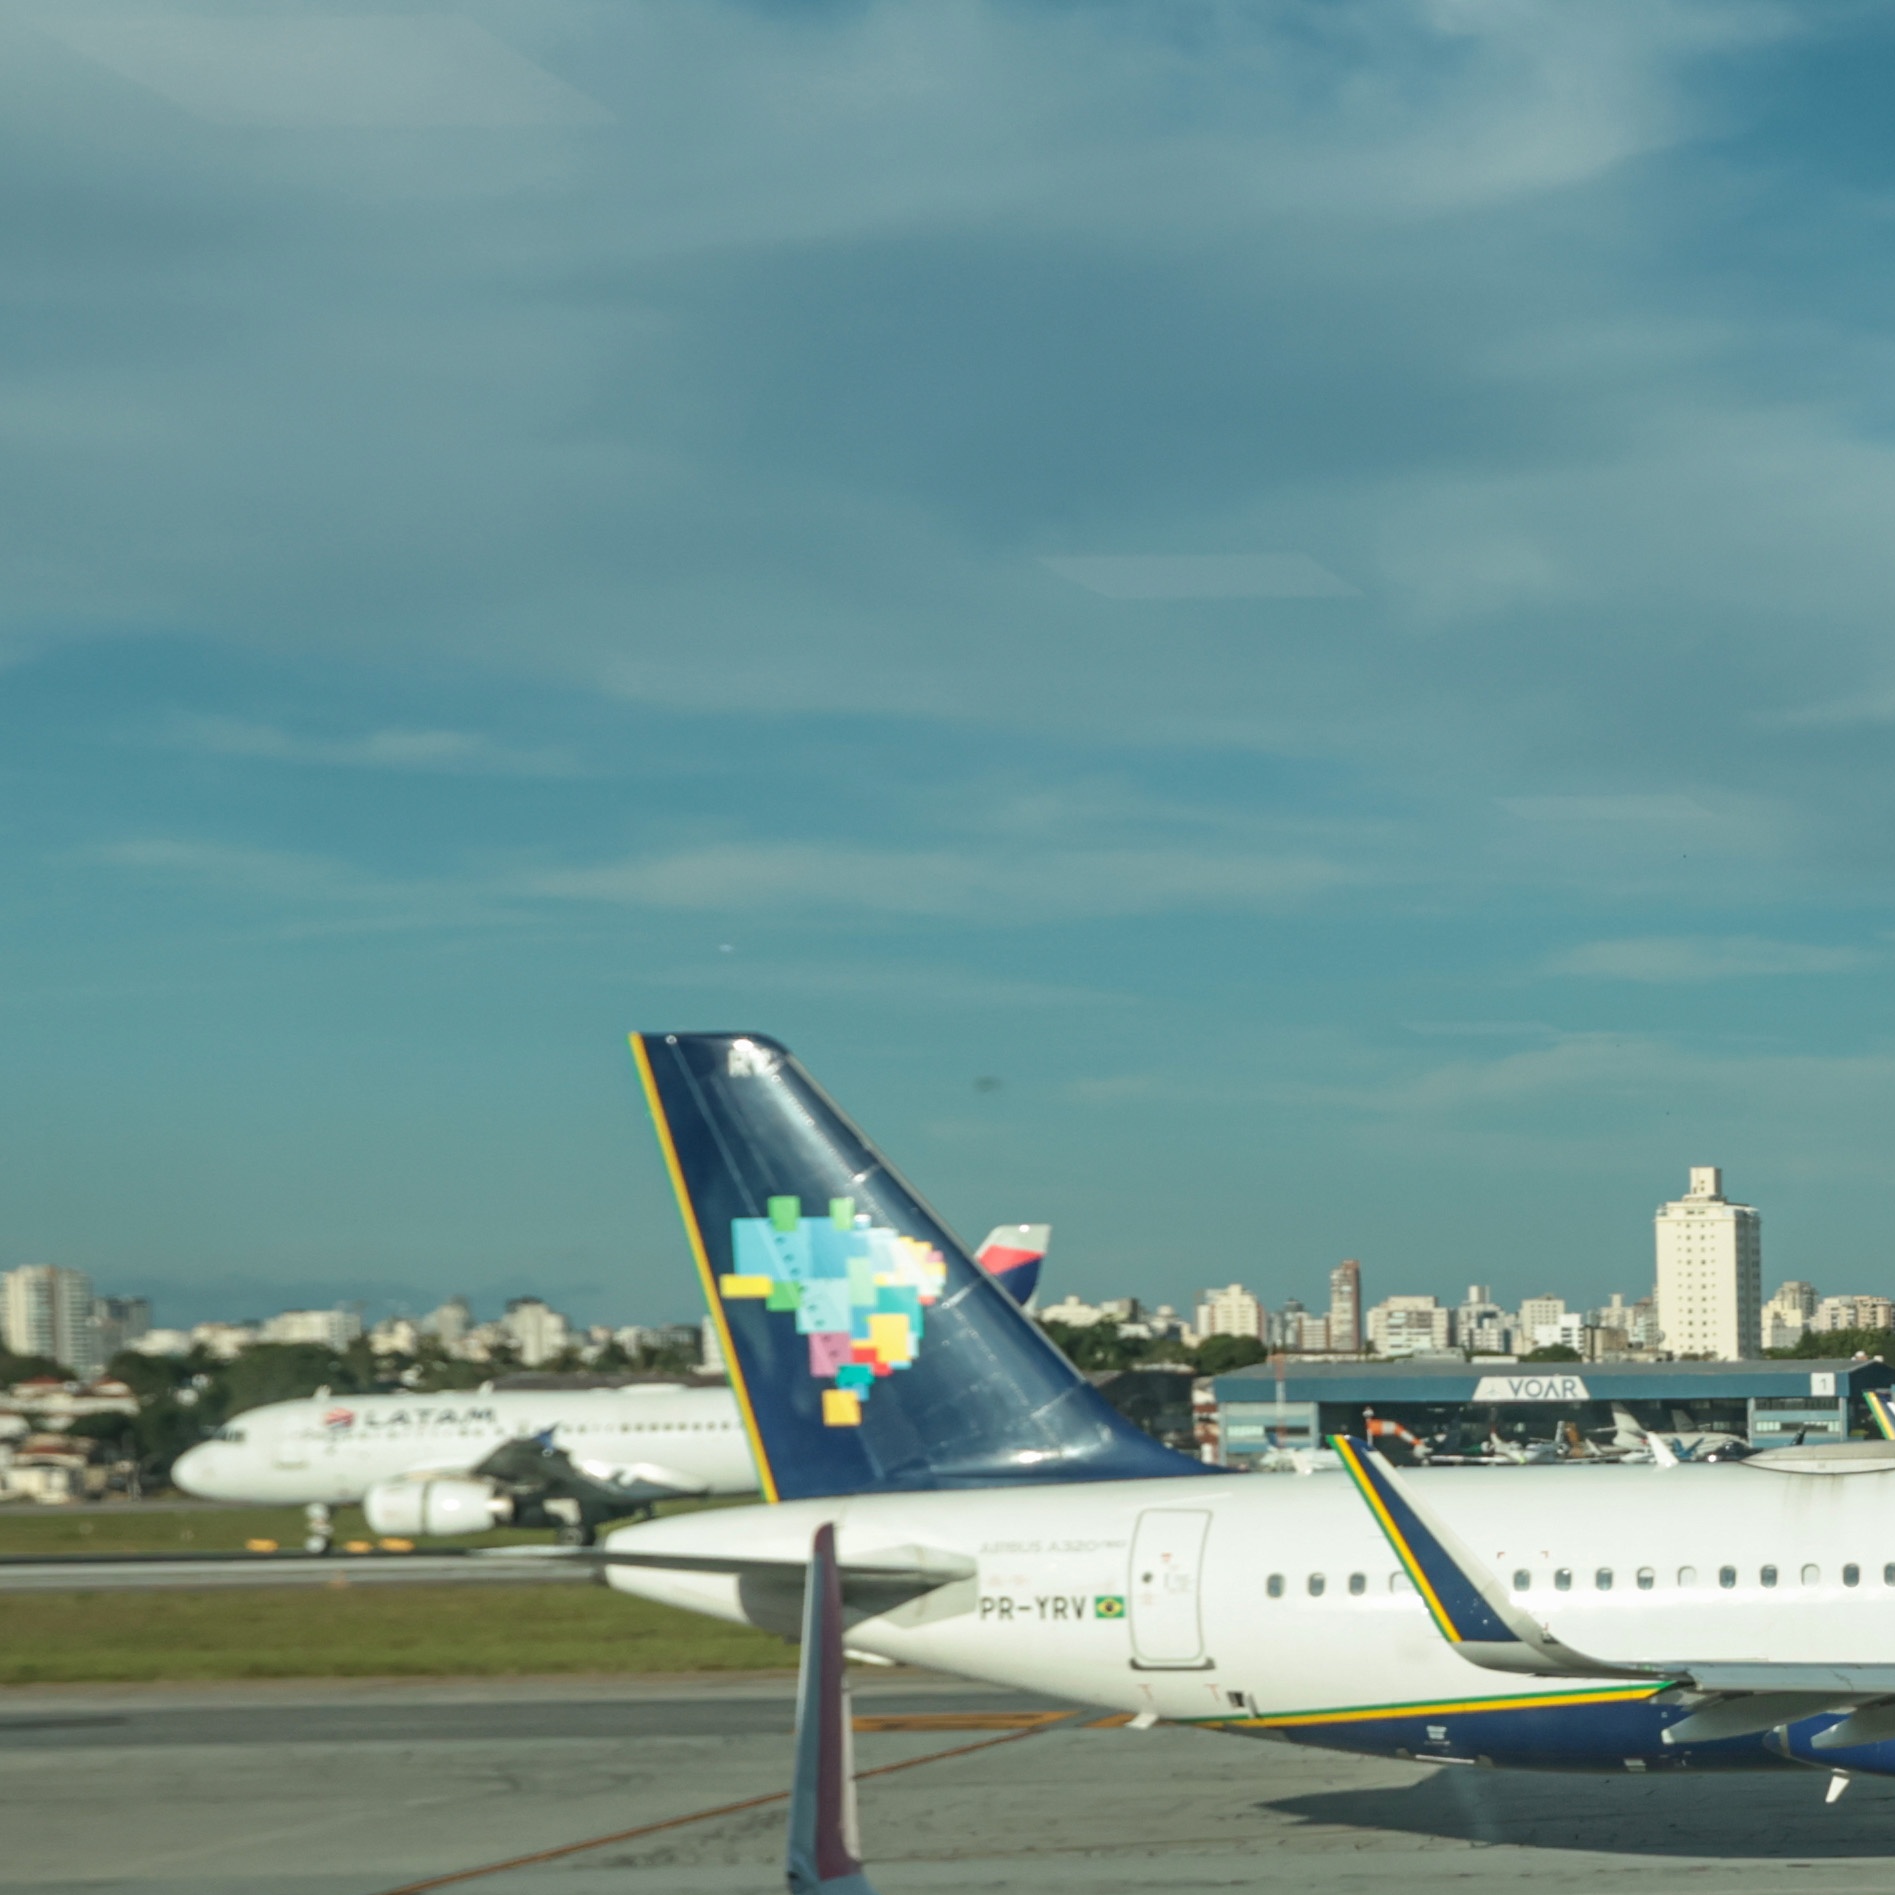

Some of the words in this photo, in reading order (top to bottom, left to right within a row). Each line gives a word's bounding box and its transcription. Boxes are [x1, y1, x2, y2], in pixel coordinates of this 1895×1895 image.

[1507, 1379, 1579, 1399] VOAR
[364, 1407, 497, 1426] LATAM
[980, 1596, 1087, 1620] PR-YRV
